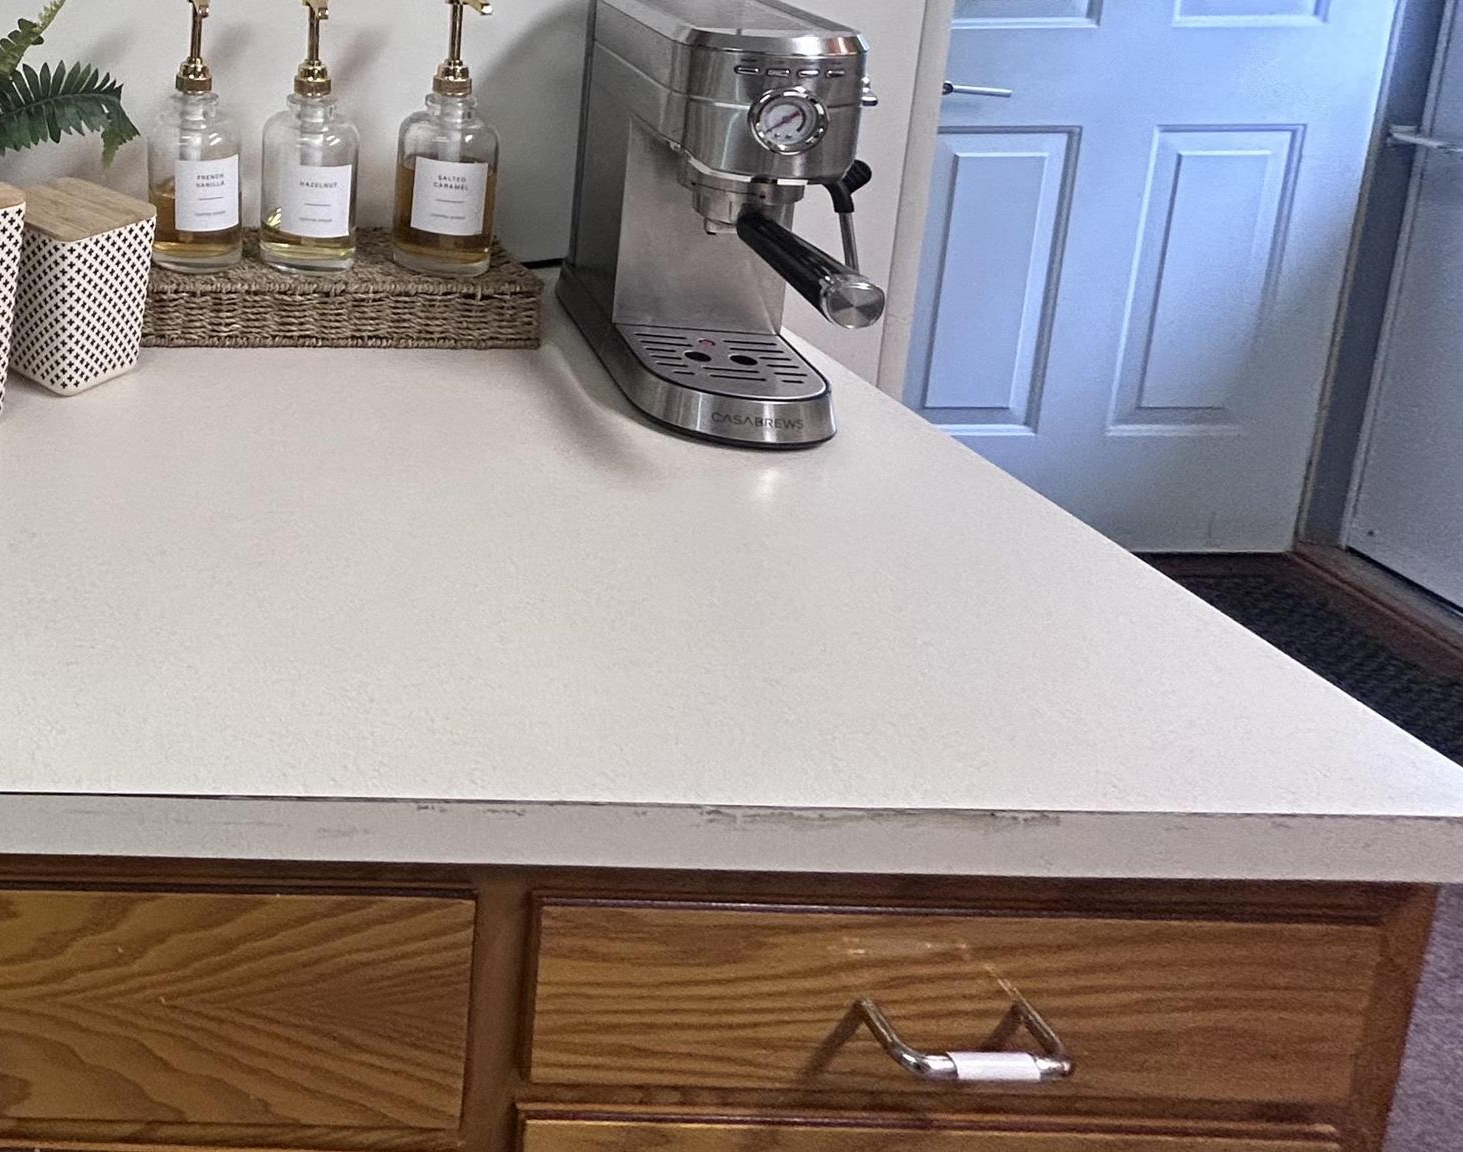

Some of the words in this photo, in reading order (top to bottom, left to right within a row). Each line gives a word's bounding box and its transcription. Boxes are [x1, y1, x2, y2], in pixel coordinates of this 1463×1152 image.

[196, 172, 225, 181] FRENCH
[437, 174, 467, 183] SALTED
[195, 180, 226, 189] VANILLA
[298, 180, 338, 190] HAZELNUT
[432, 181, 469, 191] CARAMEL
[710, 410, 805, 431] CASABREWS
